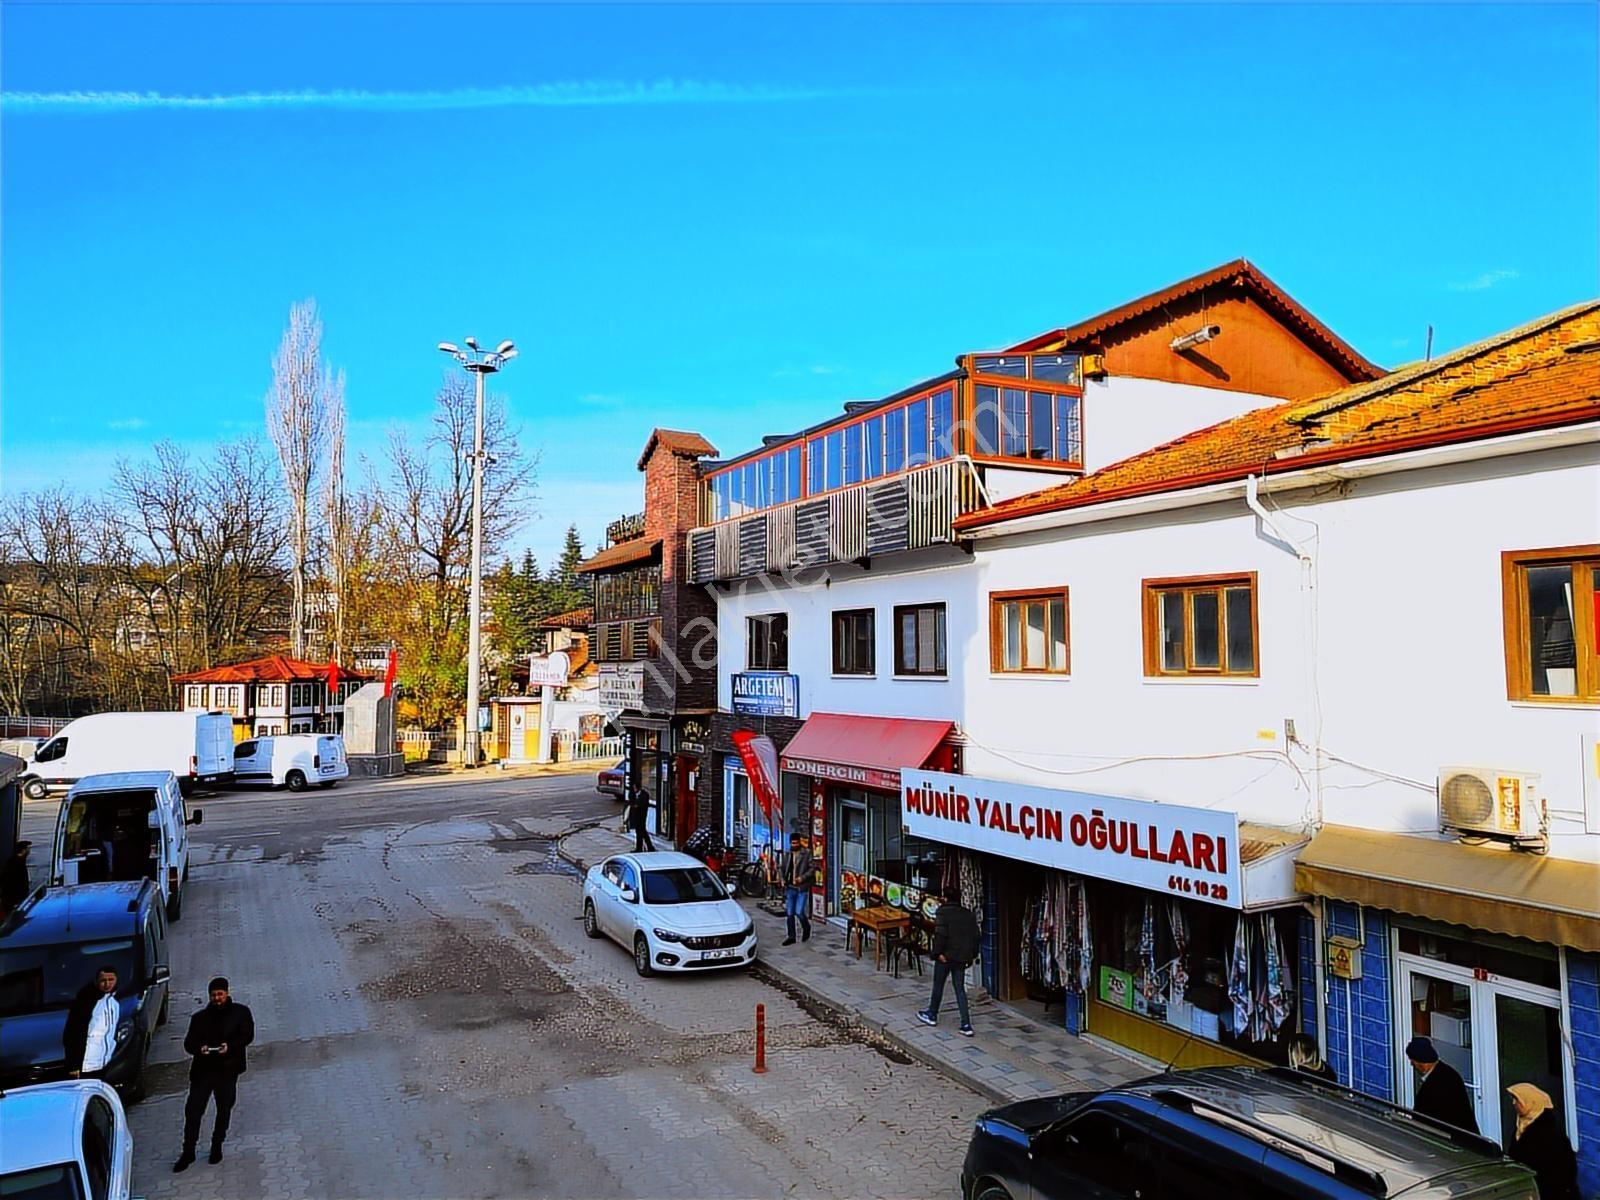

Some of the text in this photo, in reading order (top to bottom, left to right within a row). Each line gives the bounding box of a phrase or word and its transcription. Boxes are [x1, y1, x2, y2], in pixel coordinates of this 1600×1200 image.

[733, 676, 783, 697] ARGETEM
[906, 782, 1227, 874] MÜNİR YALÇIN OĞULLARI
[1168, 875, 1191, 892] 616
